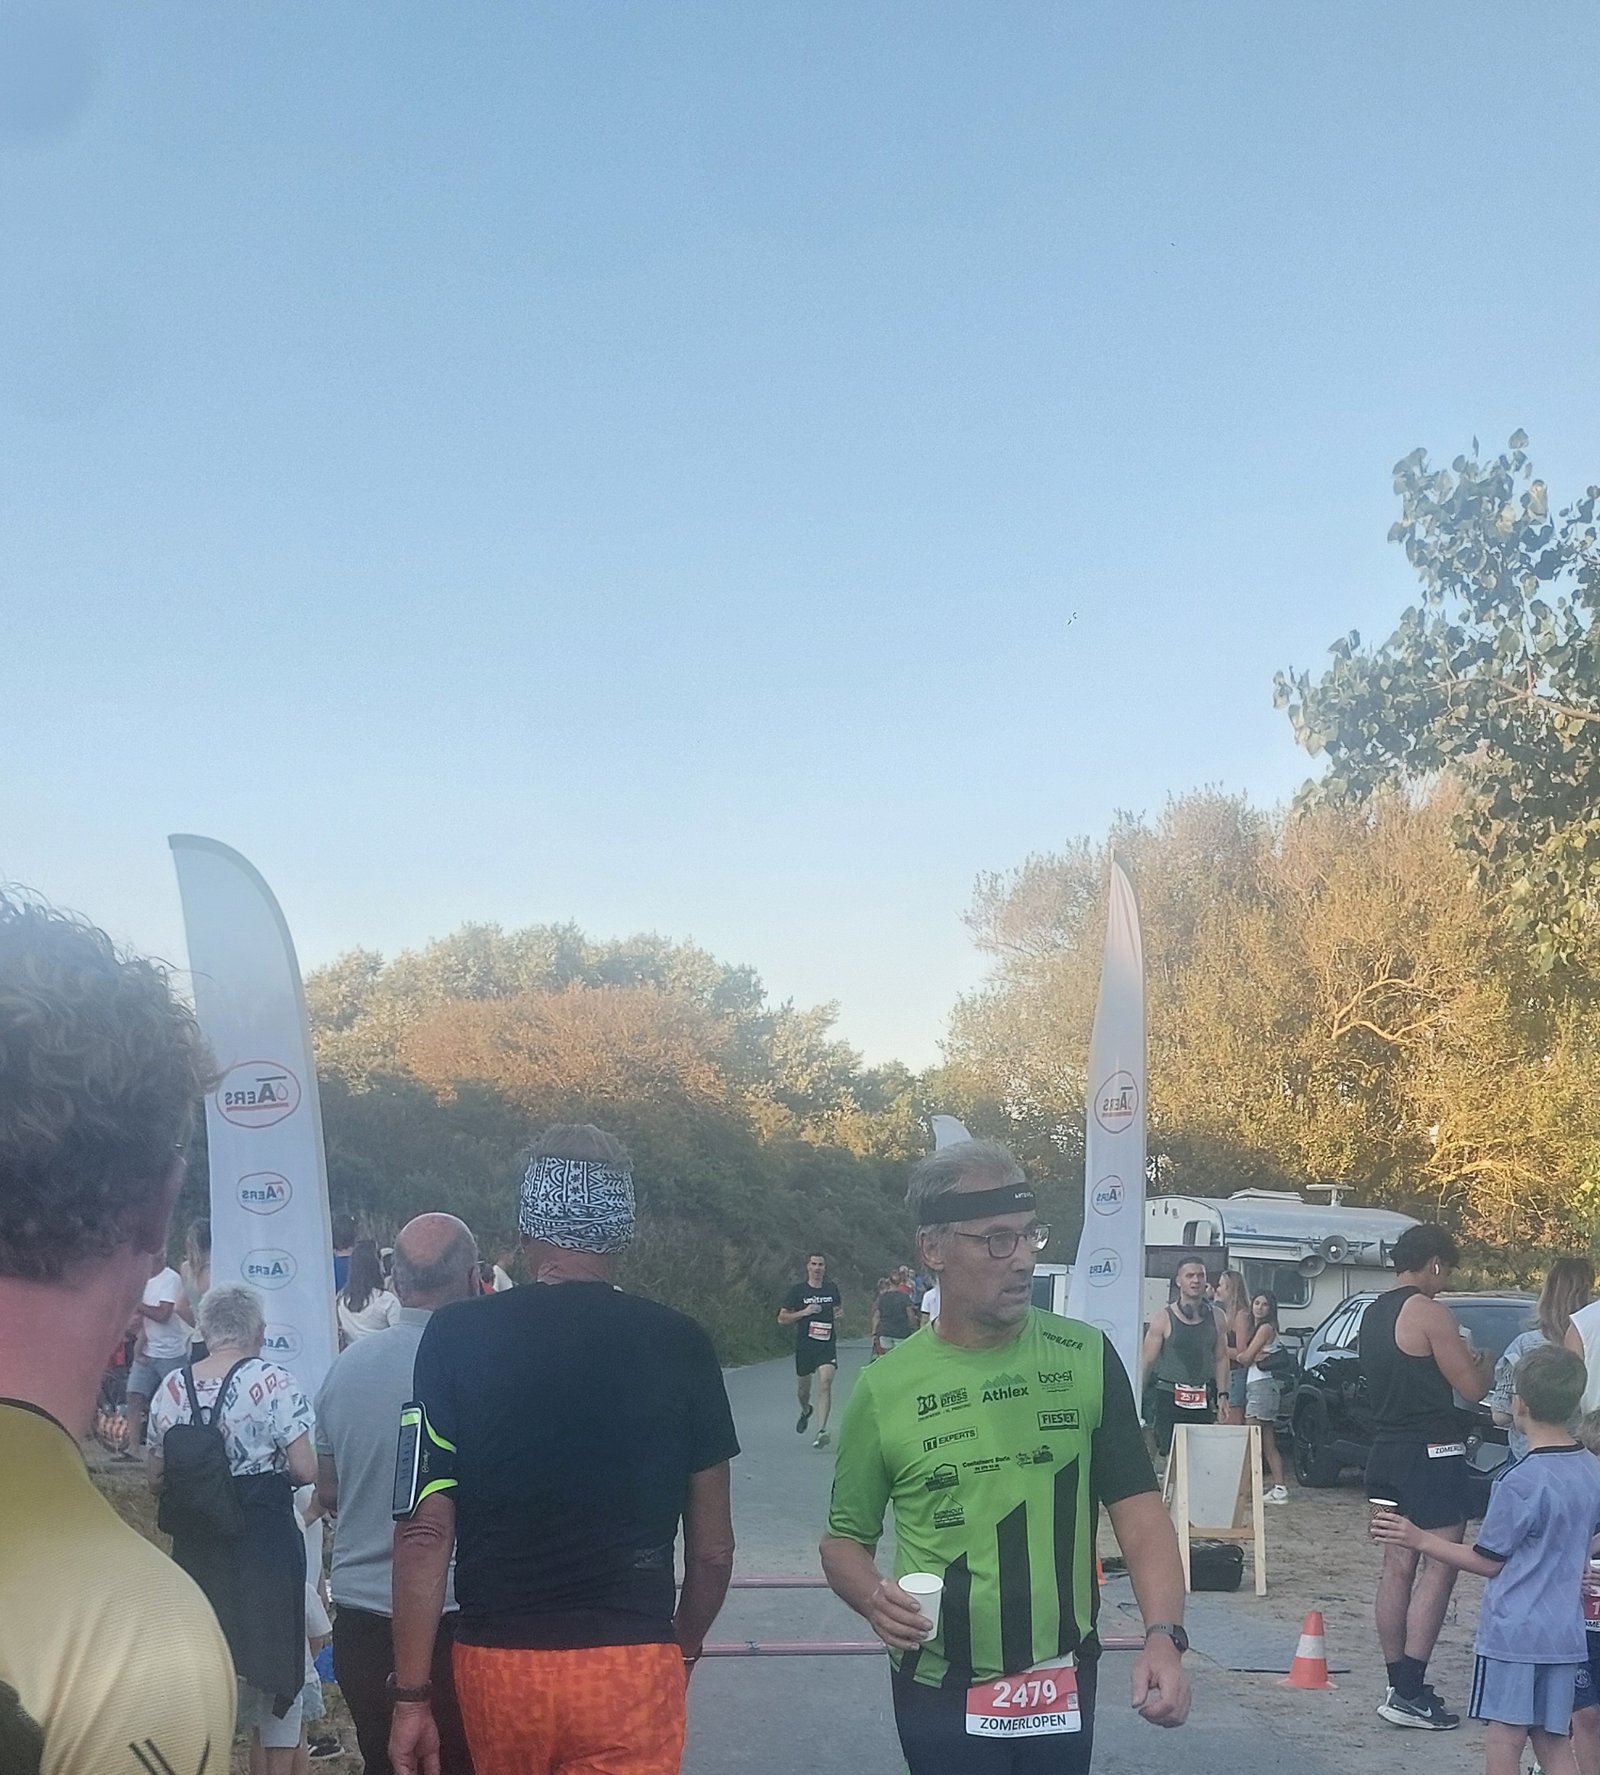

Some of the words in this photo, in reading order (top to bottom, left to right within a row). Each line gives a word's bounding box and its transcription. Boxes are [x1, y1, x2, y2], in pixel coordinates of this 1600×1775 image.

[982, 1385, 1029, 1403] Athlex
[938, 1429, 976, 1444] EXPERTS
[992, 1679, 1058, 1708] 2479
[980, 1714, 1067, 1731] ZOMERLOPEN
